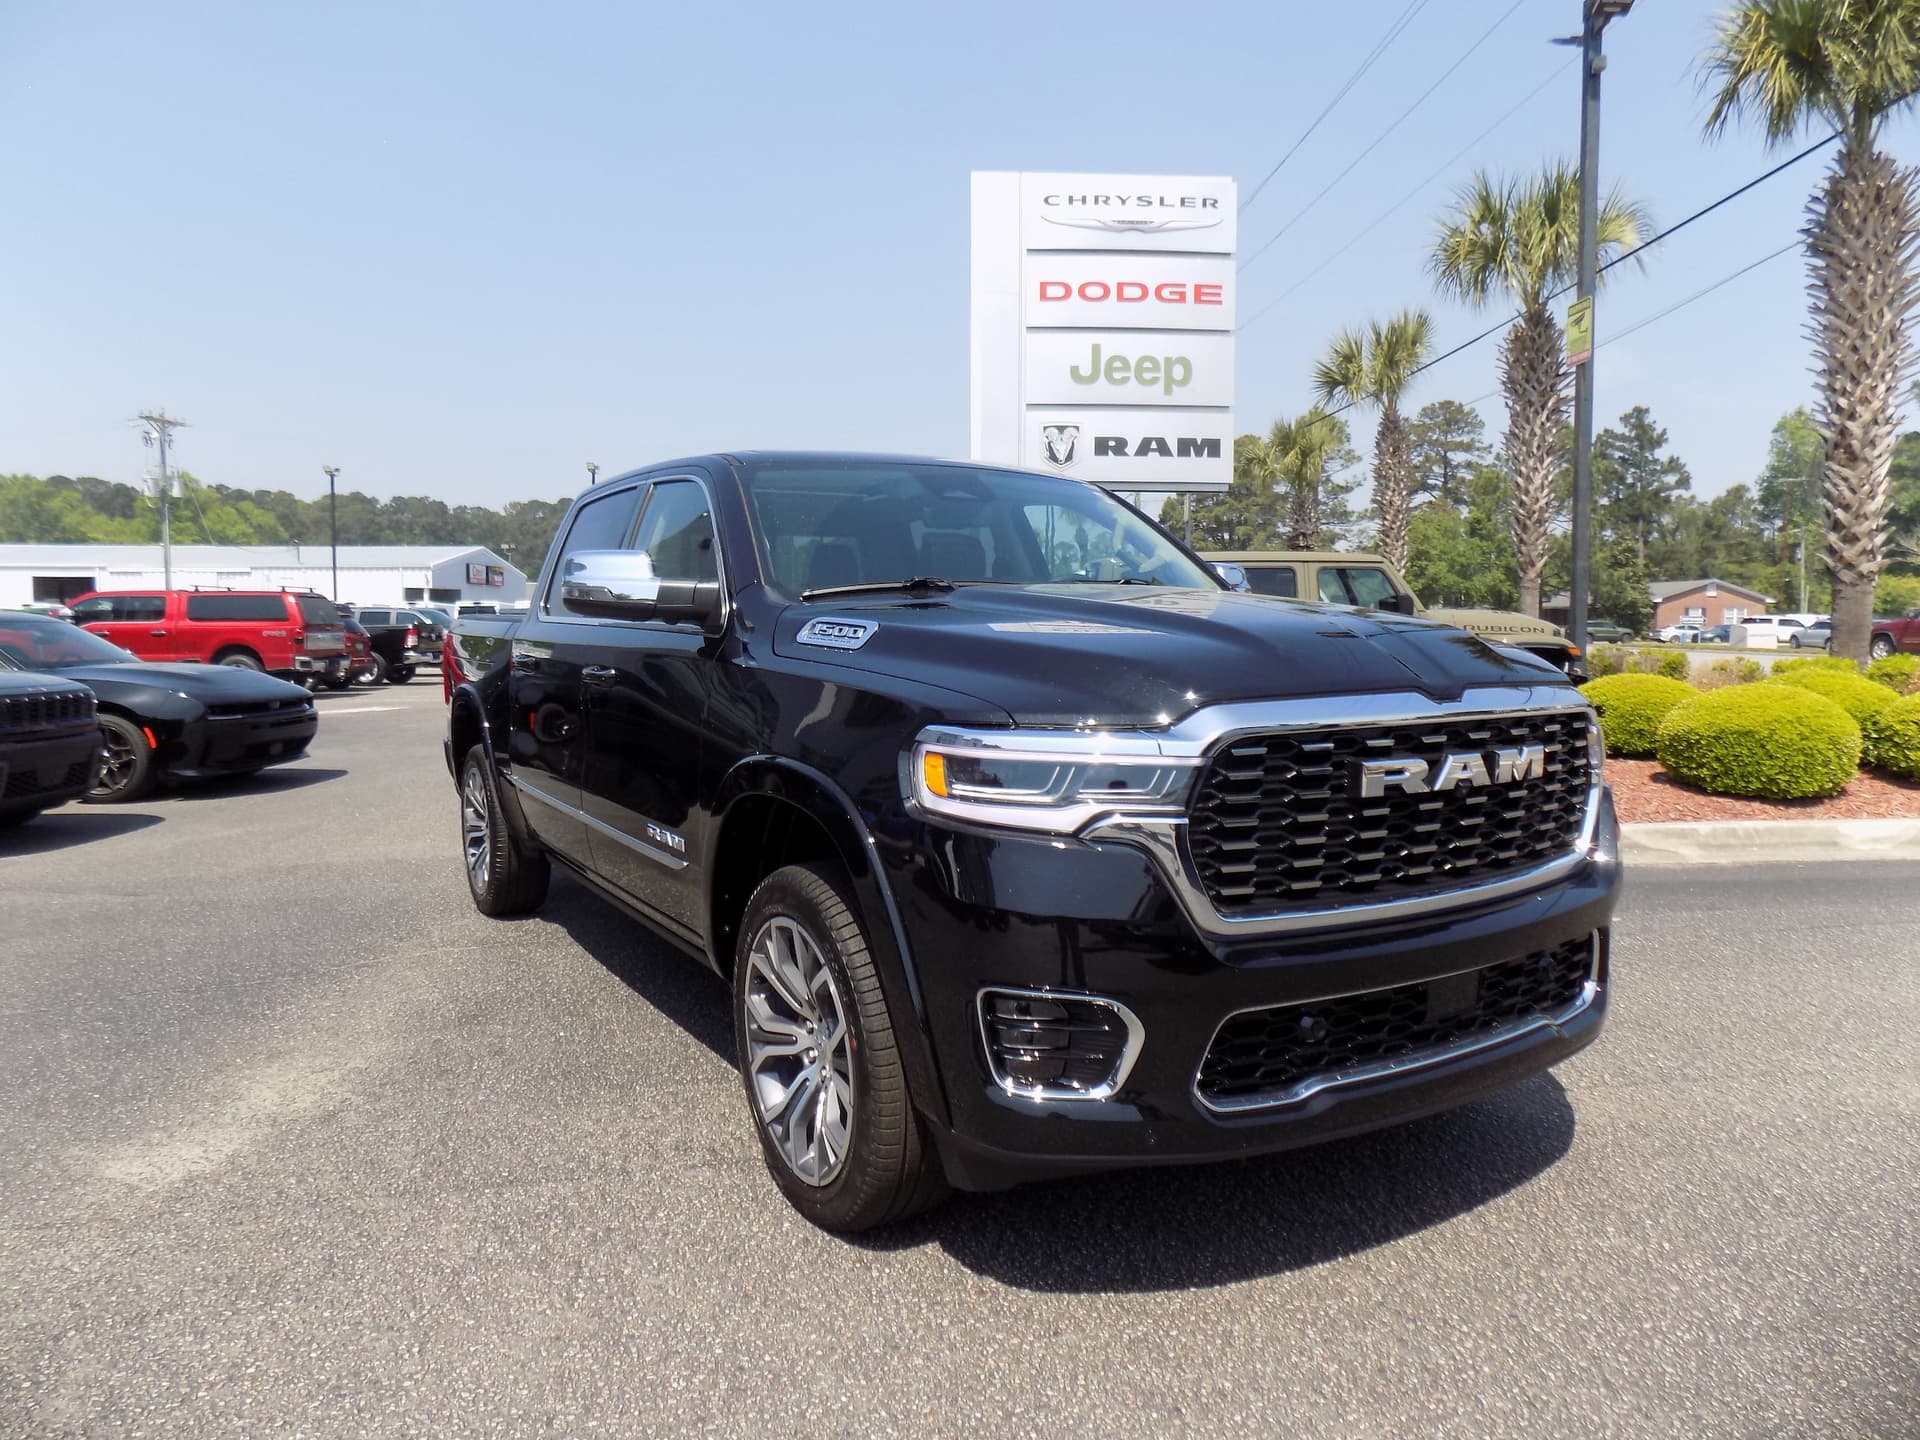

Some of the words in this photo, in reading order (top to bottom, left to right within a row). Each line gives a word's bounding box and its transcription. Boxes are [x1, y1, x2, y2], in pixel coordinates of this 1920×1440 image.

[1043, 194, 1219, 209] CHRYSLER
[1039, 281, 1223, 306] DODGE
[1069, 343, 1193, 396] Jeep
[1093, 436, 1222, 458] RAM
[812, 622, 865, 638] 1500
[1463, 624, 1545, 634] RUBICON
[1360, 744, 1545, 799] RAM
[646, 823, 686, 853] RAM
